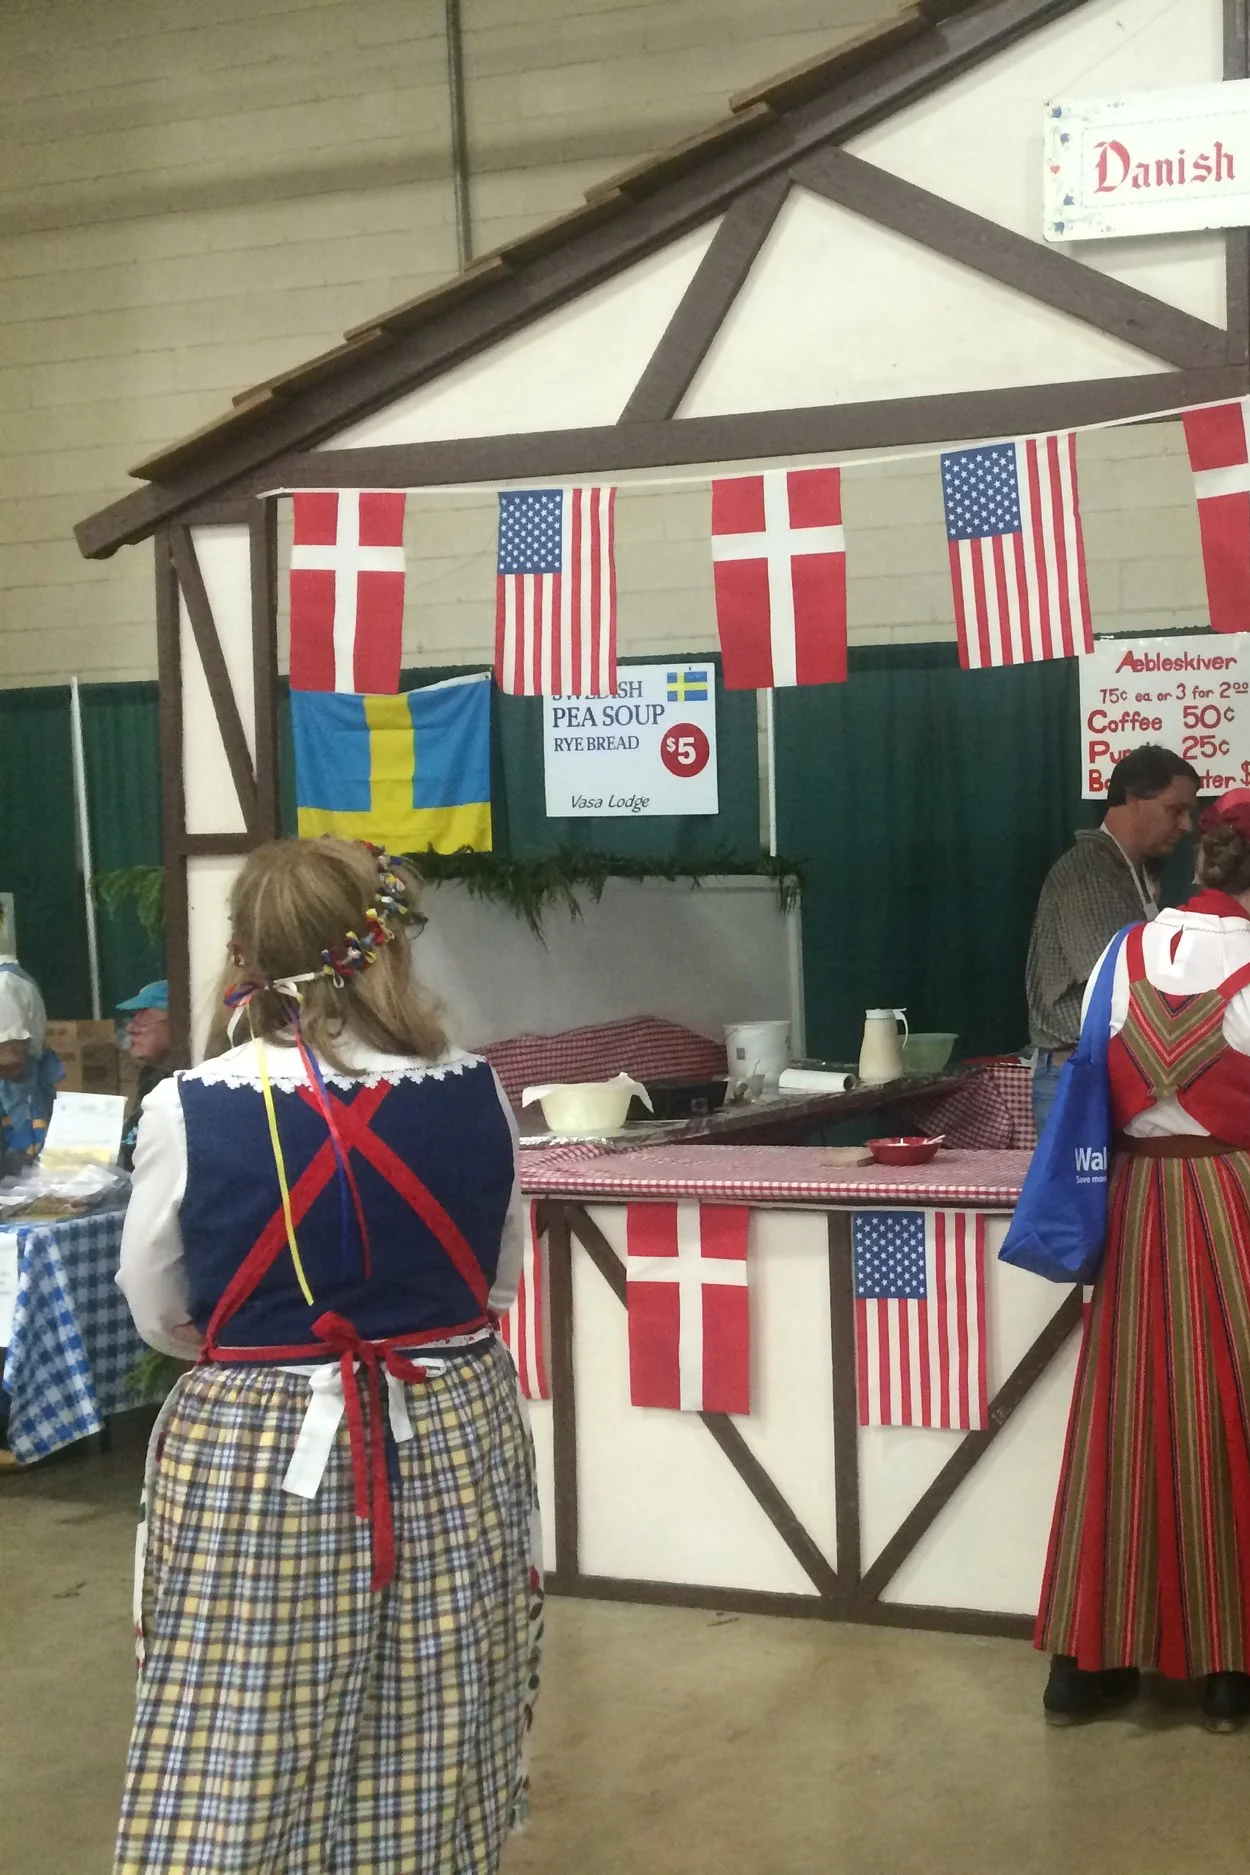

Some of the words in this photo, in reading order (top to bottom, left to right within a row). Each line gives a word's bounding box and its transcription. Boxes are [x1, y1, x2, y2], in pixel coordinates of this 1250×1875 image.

[1094, 140, 1236, 194] Danish
[1157, 692, 1173, 701] or
[1176, 683, 1187, 700] 3
[1192, 685, 1214, 700] for
[552, 707, 598, 728] PEA
[602, 704, 665, 726] SOUP
[1087, 709, 1163, 734] Coffee
[554, 737, 584, 751] RYE
[586, 735, 640, 751] BREAD
[666, 736, 697, 765] $5
[571, 795, 603, 808] Vasa
[608, 794, 650, 813] Lodge
[1075, 1146, 1107, 1171] Wal
